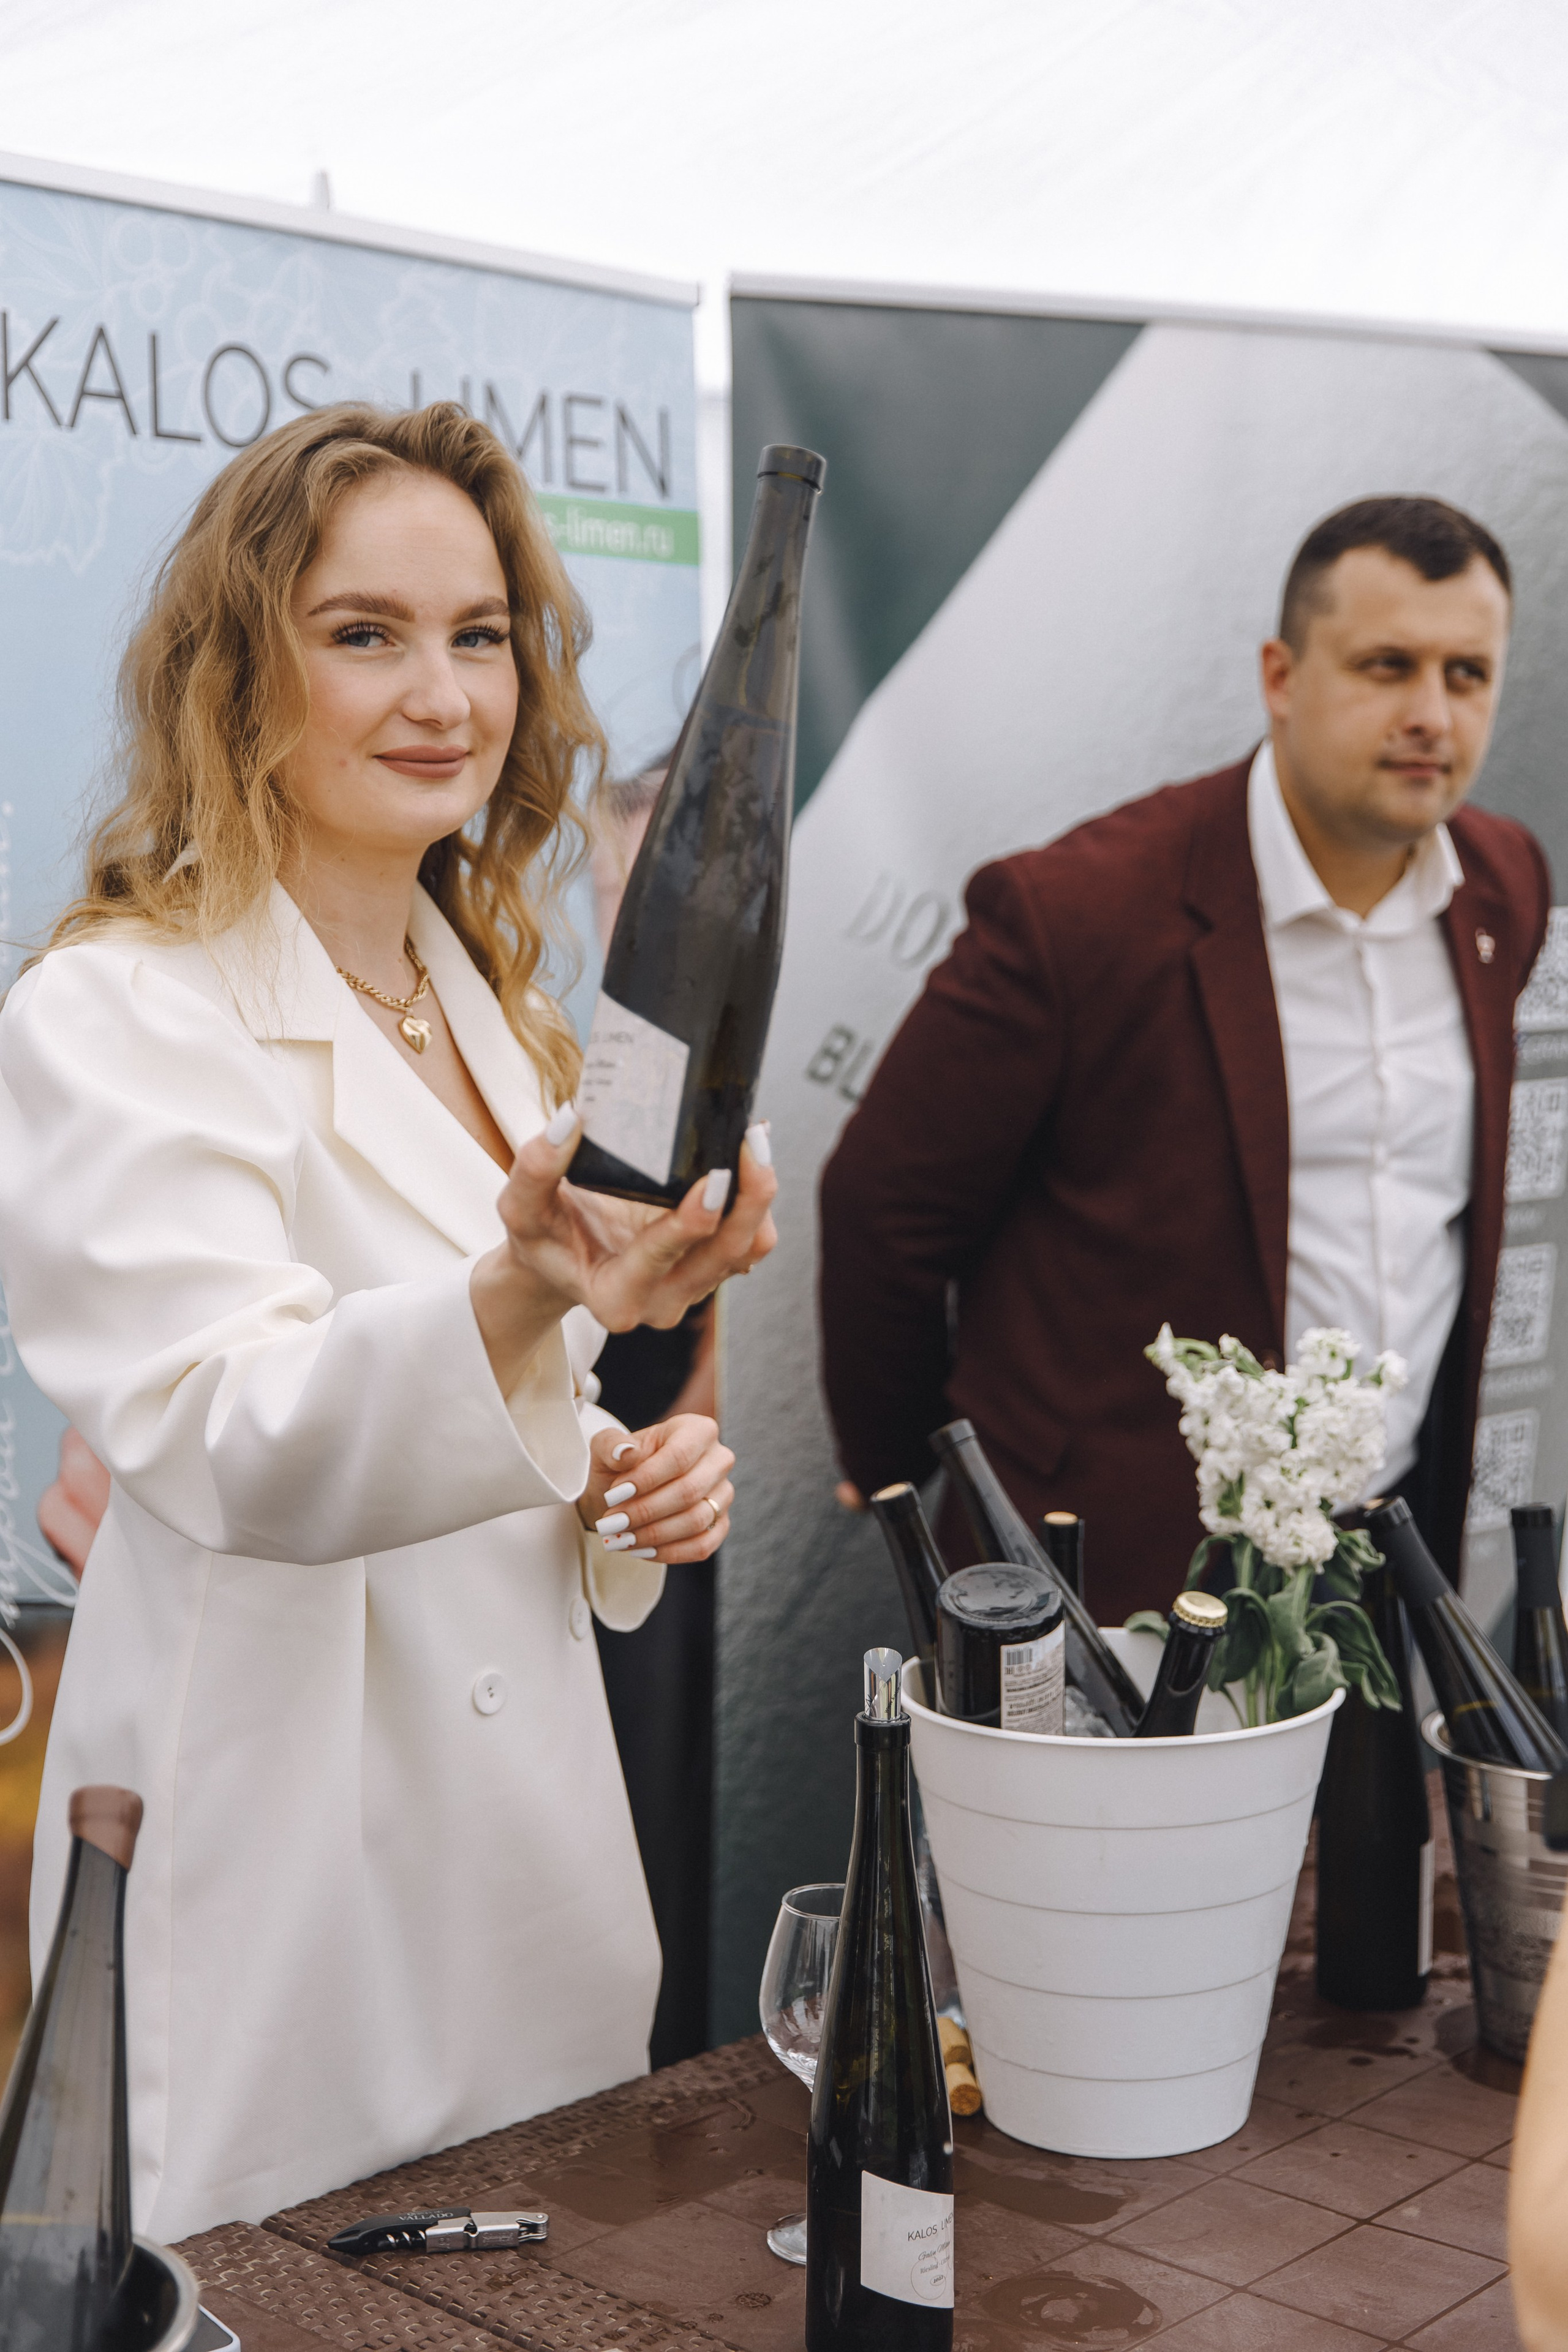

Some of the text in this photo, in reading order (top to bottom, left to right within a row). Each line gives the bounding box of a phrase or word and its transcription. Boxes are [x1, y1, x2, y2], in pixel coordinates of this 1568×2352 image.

[1, 309, 331, 449] KALOS
[543, 503, 674, 559] s-limen.ru
[399, 2212, 454, 2222] VALLADO
[908, 2225, 938, 2242] KALOS
